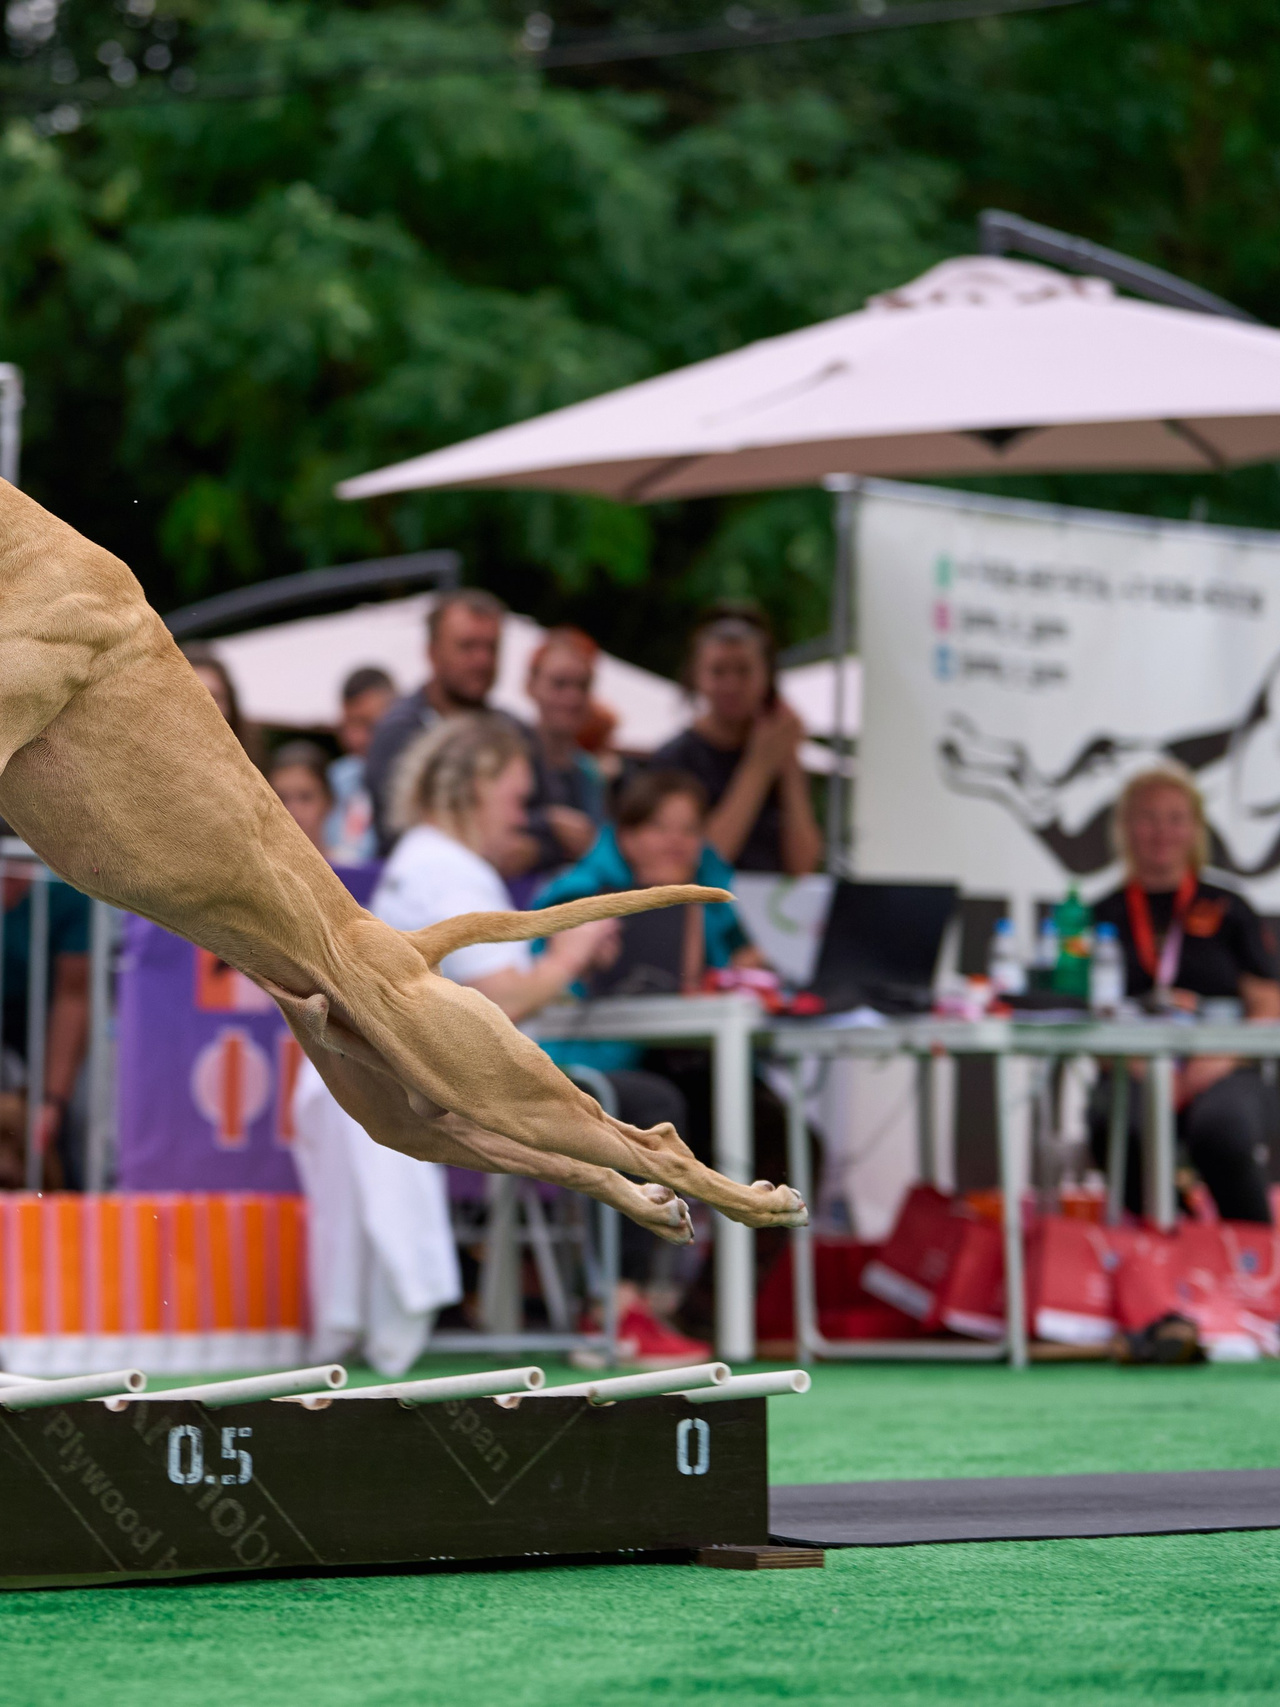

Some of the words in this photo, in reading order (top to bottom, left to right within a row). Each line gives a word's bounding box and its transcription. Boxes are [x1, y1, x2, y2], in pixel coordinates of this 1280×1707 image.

[166, 1423, 254, 1486] 0.5
[675, 1417, 712, 1477] 0
[43, 1410, 164, 1556] Plywood
